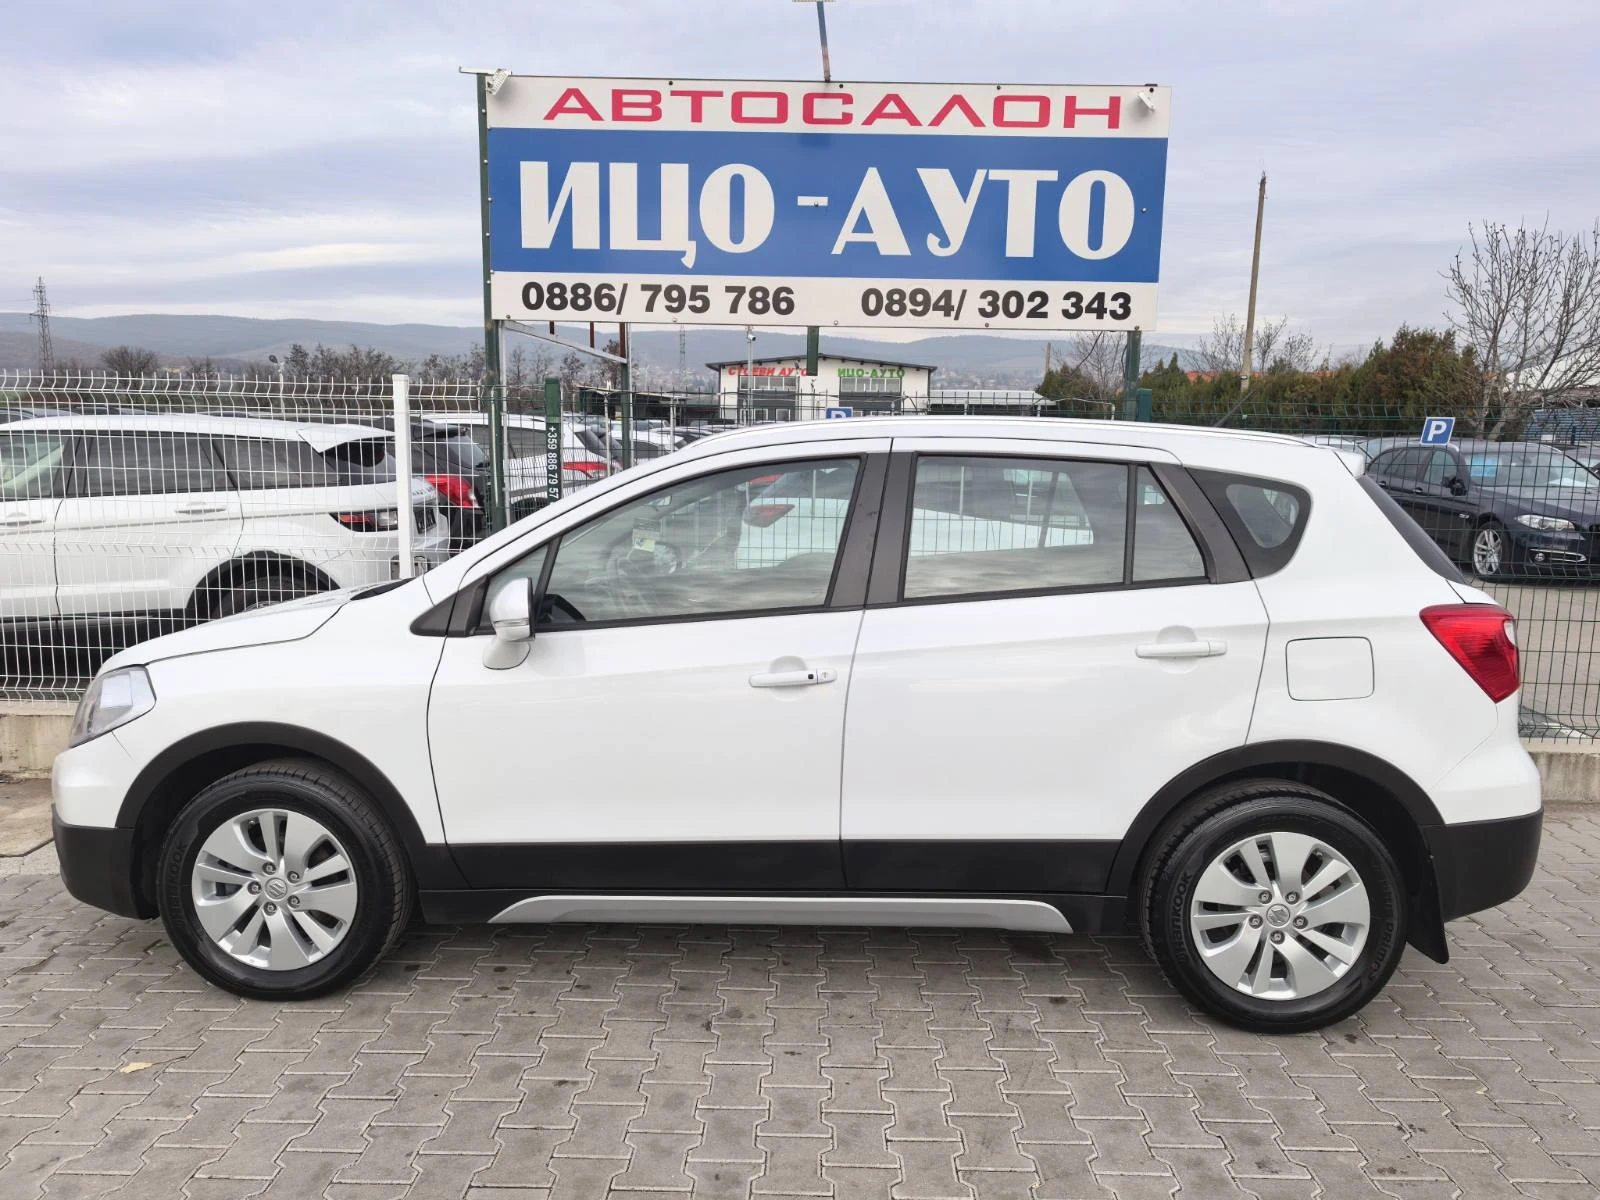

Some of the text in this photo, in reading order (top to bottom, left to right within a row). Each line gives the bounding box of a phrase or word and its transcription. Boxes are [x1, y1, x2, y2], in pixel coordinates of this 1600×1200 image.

[543, 87, 1122, 130] АВТОСАЛОН
[521, 281, 795, 316] 0886/ 795 786
[861, 287, 1132, 321] 0894/ 302 343
[1427, 420, 1447, 442] P
[547, 426, 559, 499] +359 886 79 57
